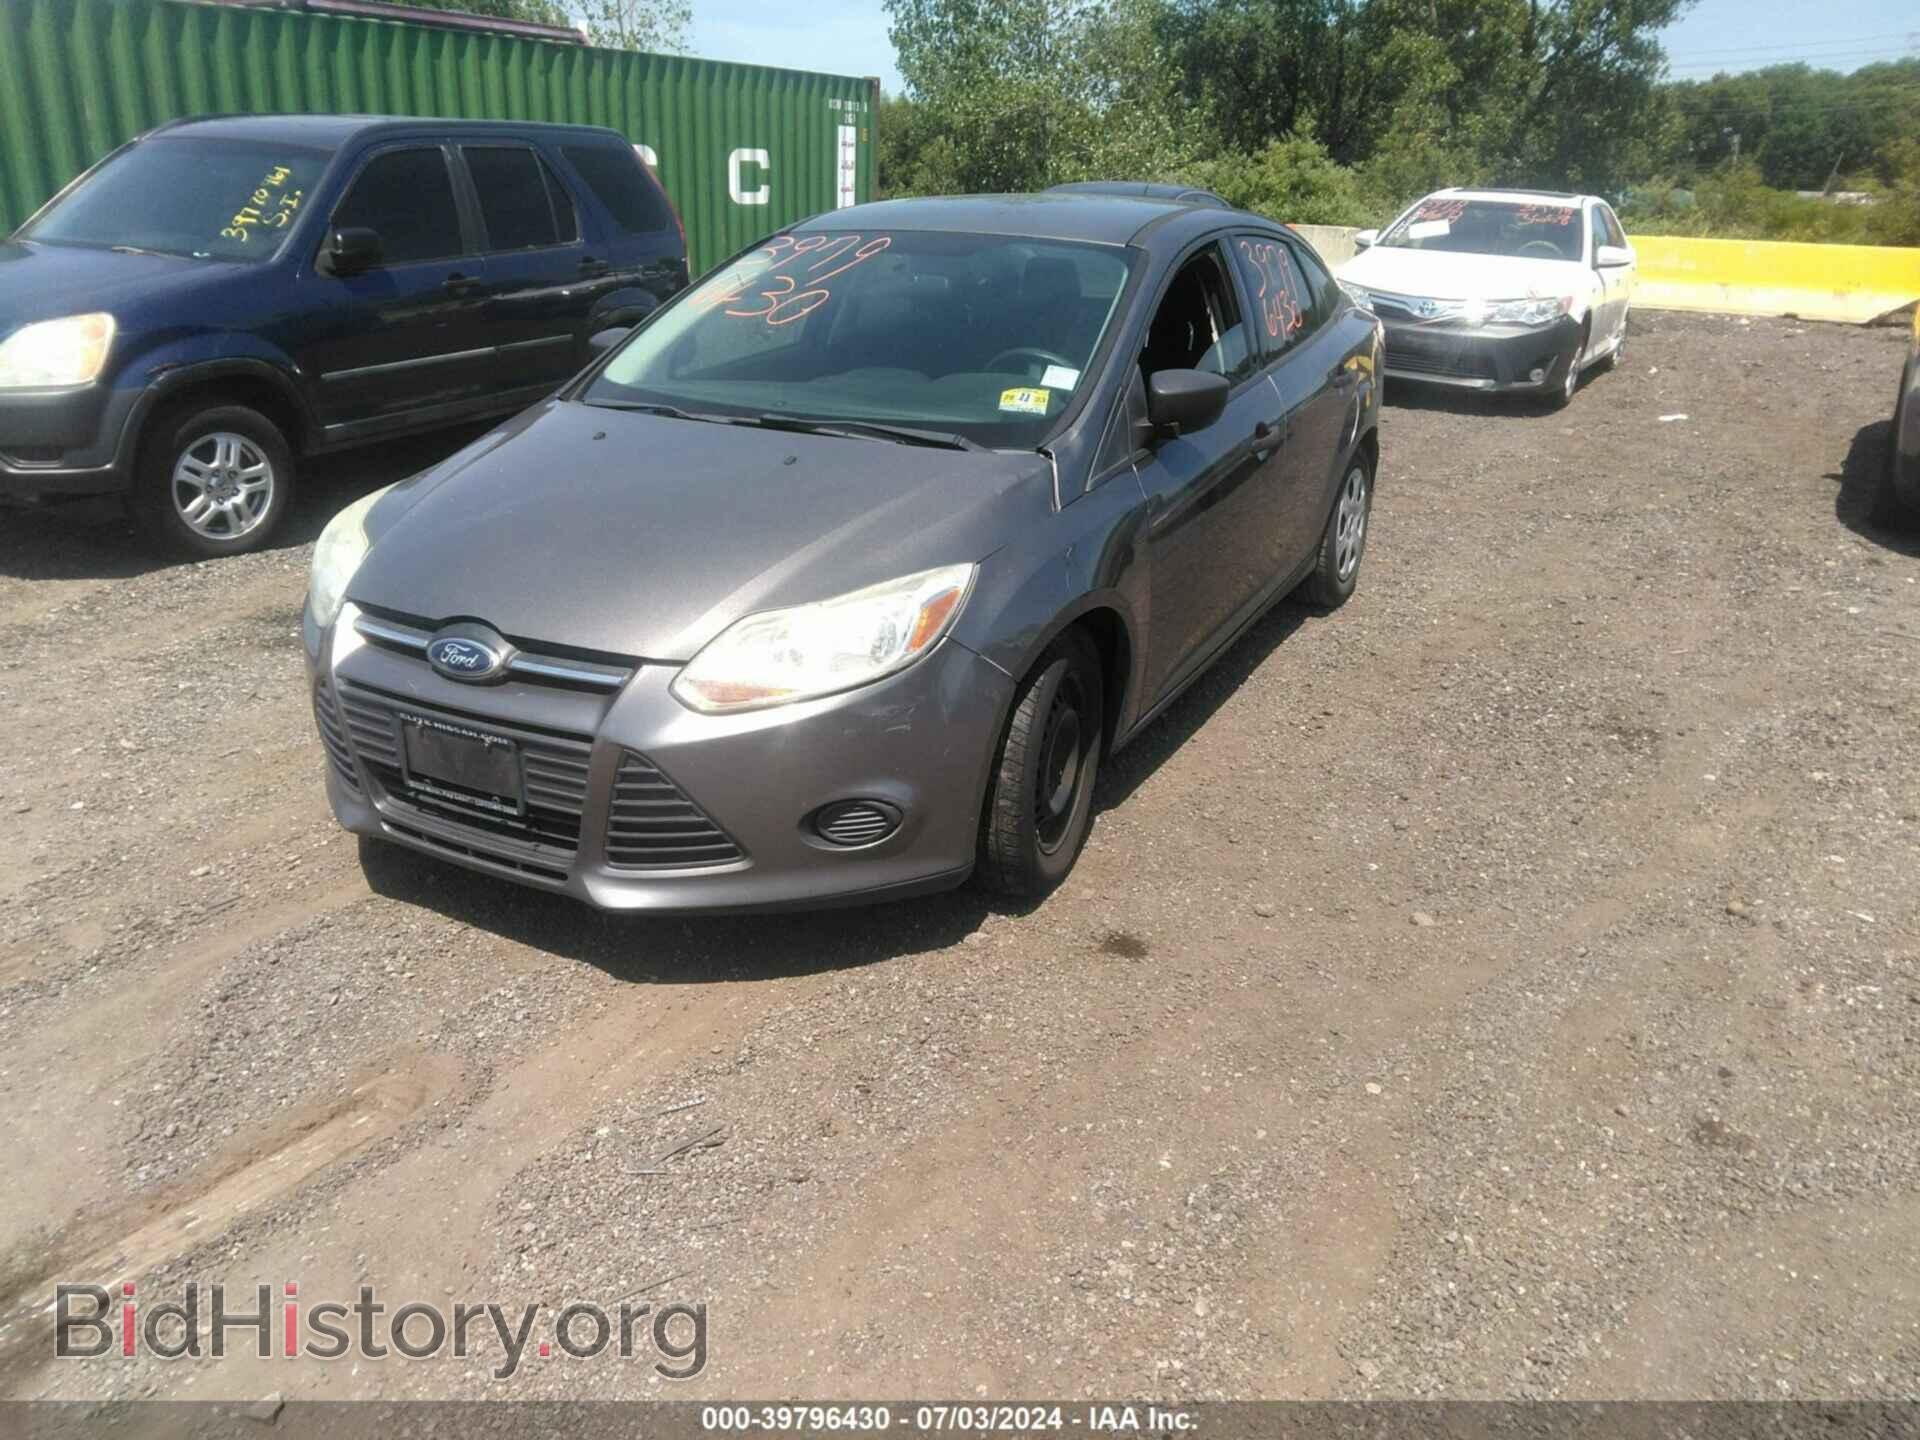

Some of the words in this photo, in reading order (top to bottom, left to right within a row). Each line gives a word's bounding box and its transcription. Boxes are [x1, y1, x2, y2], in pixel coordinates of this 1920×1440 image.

[728, 148, 771, 205] C
[736, 235, 891, 287] 3979
[440, 643, 480, 669] Ford
